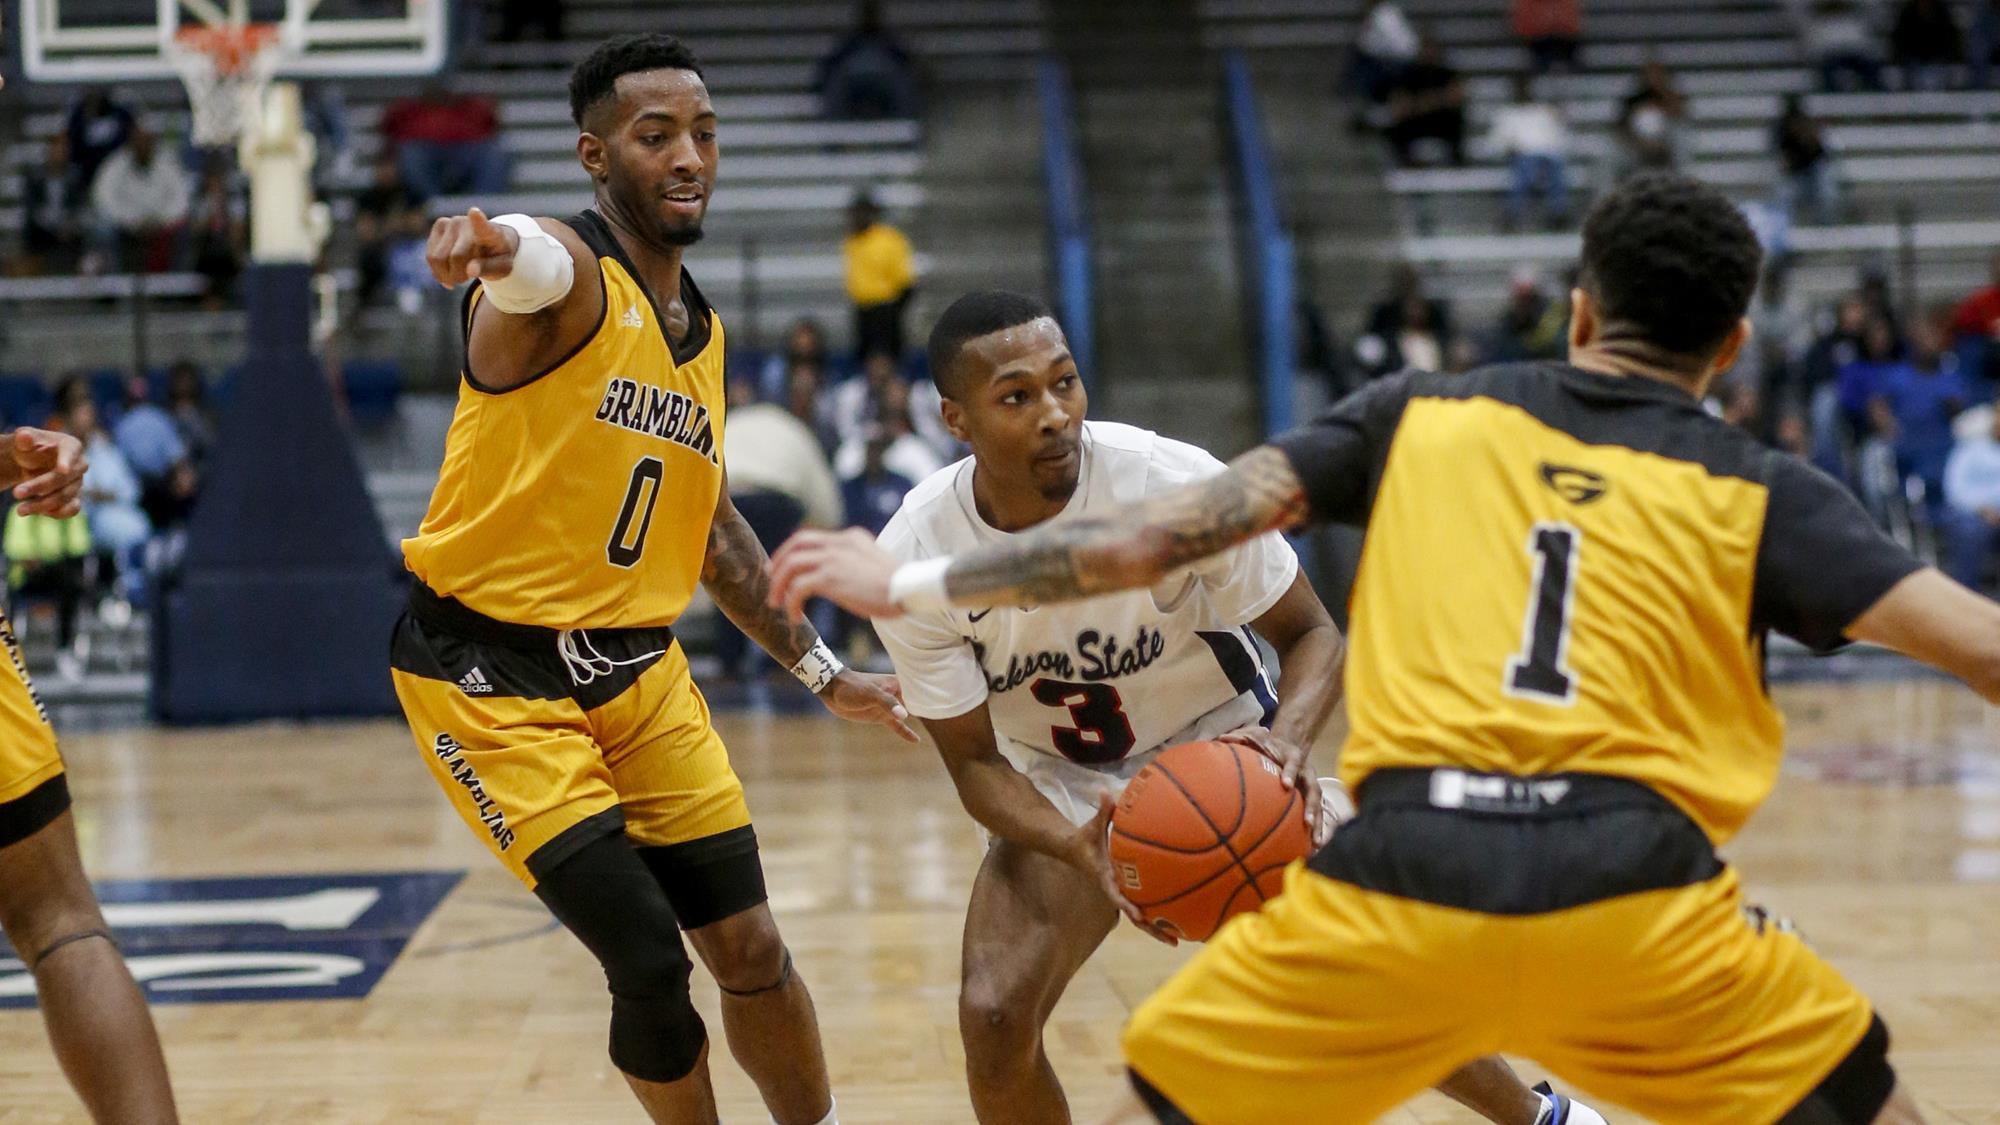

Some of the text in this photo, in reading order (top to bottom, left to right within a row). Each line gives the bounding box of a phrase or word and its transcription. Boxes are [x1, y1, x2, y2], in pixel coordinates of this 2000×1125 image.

[594, 376, 719, 467] GRAMBLIN
[605, 455, 664, 569] 0
[1503, 520, 1579, 706] 1
[966, 625, 1165, 694] ckson State
[1030, 677, 1137, 764] 3
